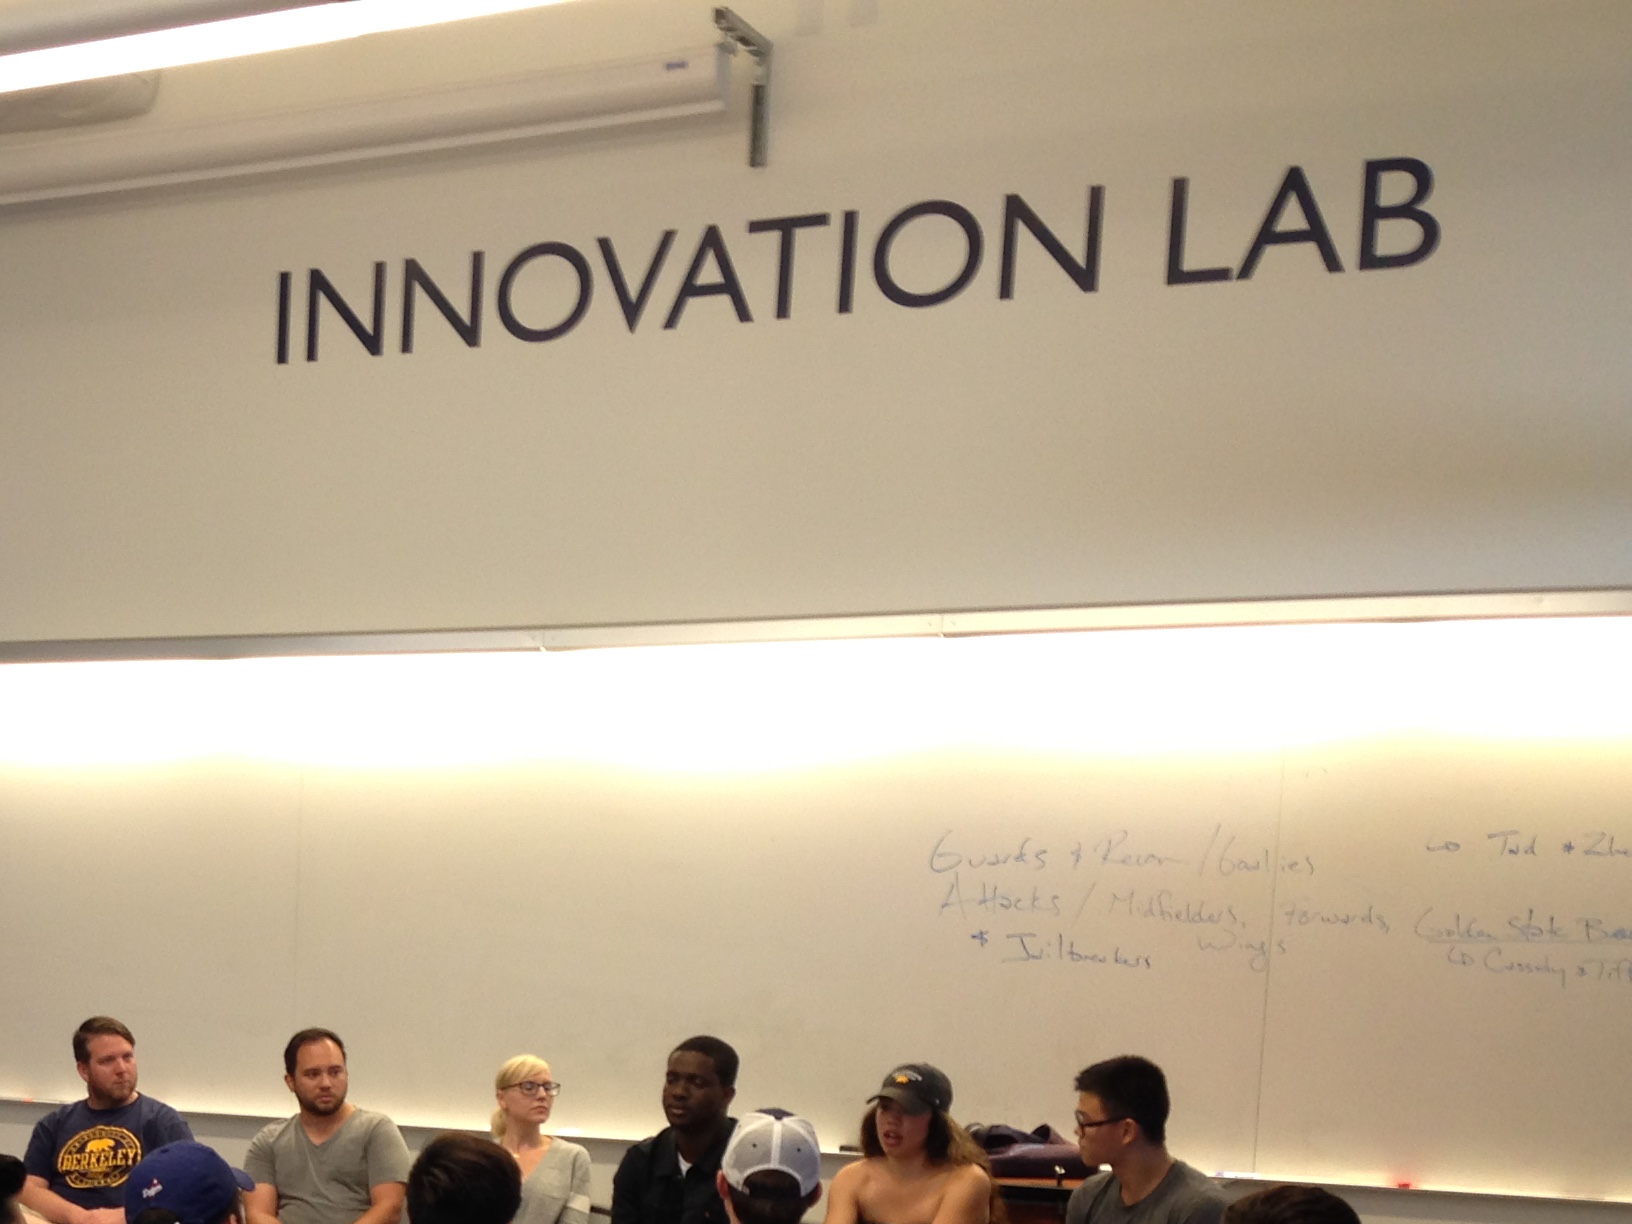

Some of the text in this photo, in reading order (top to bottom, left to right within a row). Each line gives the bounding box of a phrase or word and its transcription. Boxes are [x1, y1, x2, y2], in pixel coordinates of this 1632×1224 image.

[275, 155, 1442, 364] INNOVATION LAB
[61, 1148, 138, 1171] BERKELEY
